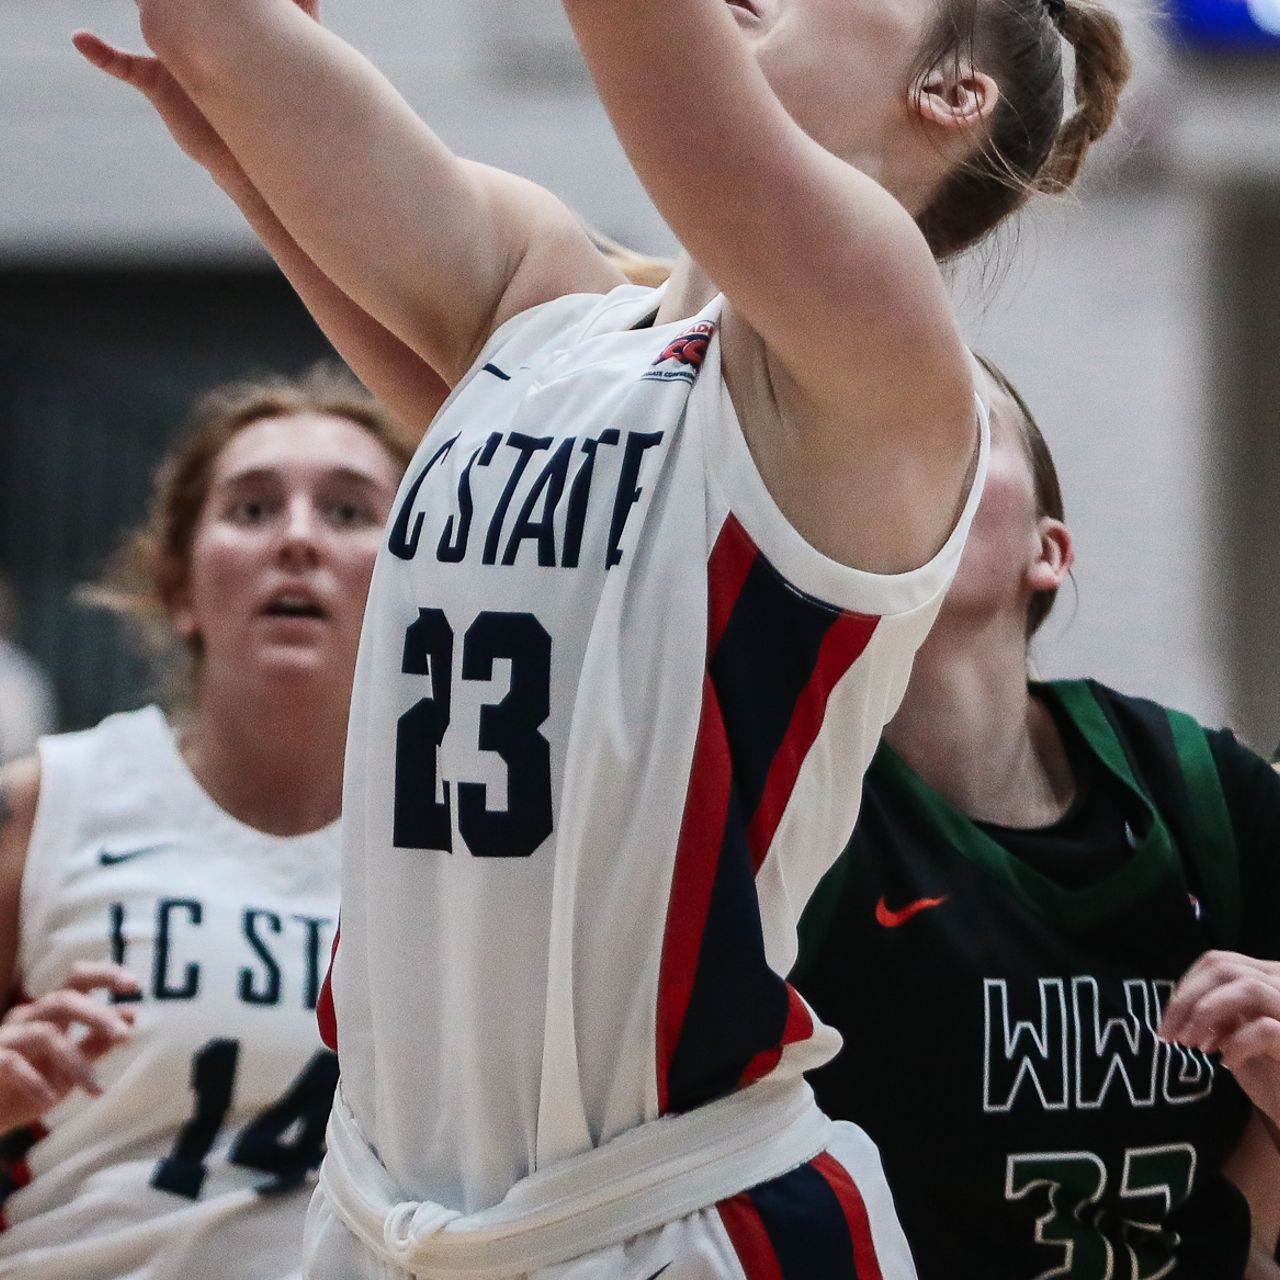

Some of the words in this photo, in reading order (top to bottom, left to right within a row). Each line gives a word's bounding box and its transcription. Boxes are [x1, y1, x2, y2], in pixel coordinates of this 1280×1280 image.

[436, 428, 665, 571] STATE
[394, 606, 554, 858] 23
[108, 896, 204, 1004] LC
[983, 976, 1216, 1113] WWU
[149, 1037, 340, 1200] 14
